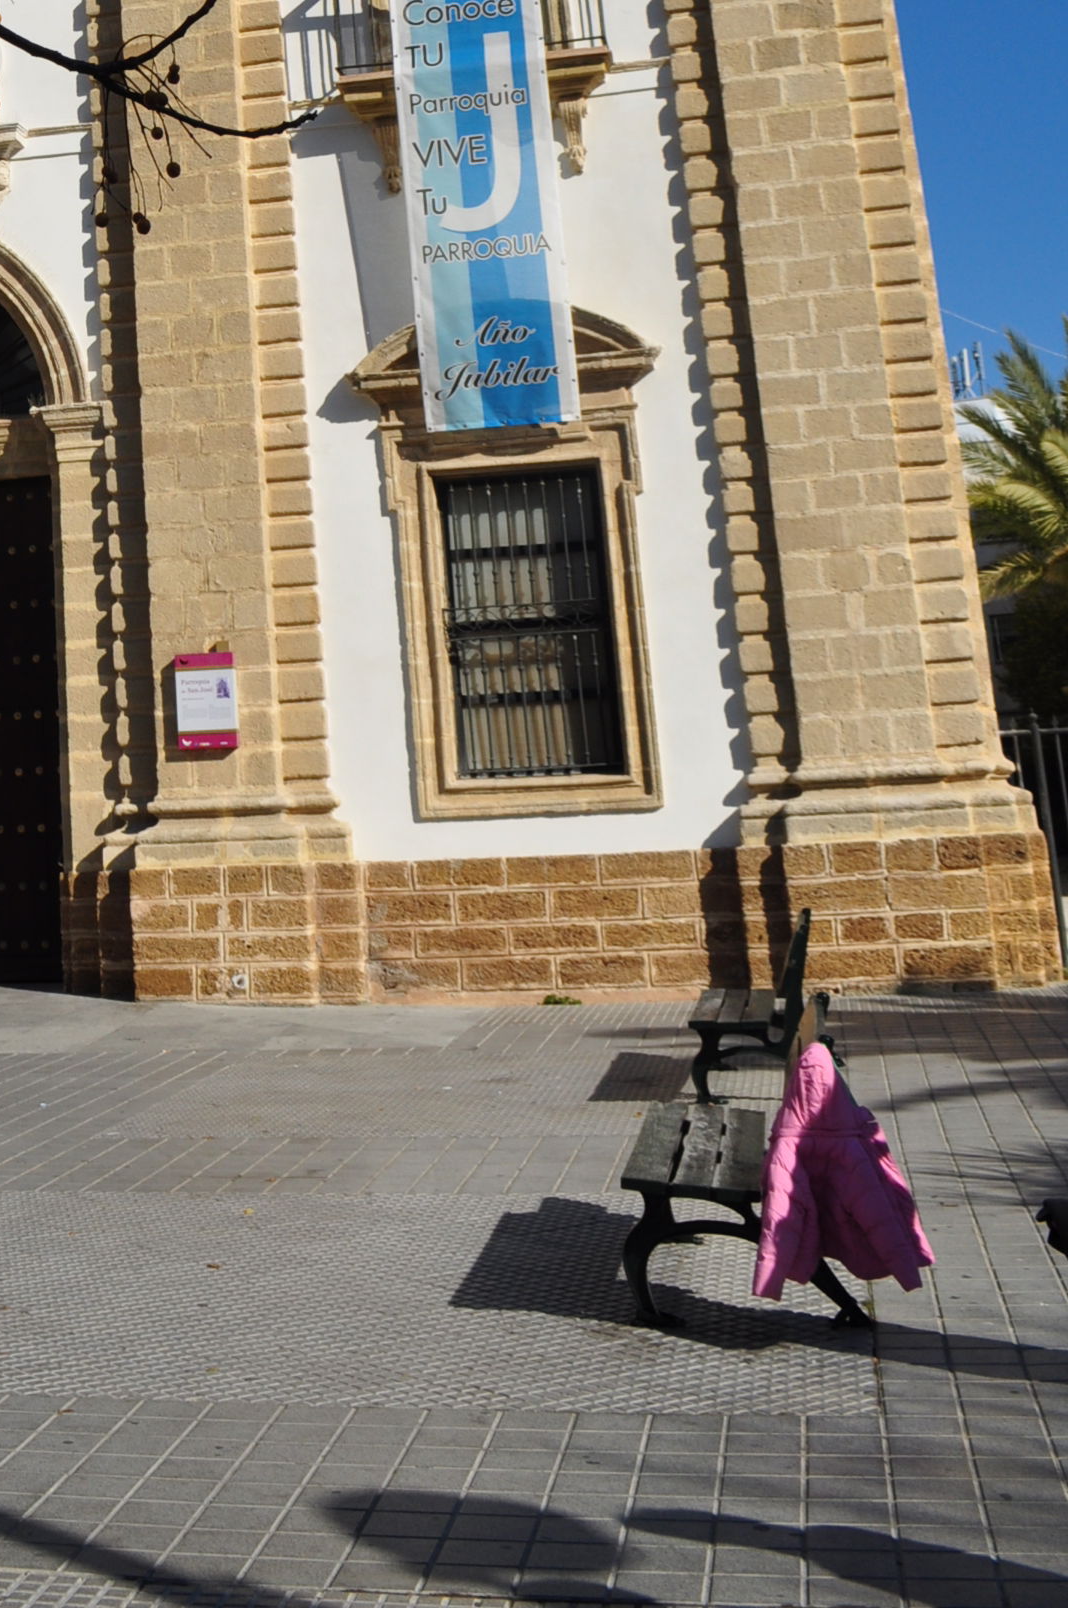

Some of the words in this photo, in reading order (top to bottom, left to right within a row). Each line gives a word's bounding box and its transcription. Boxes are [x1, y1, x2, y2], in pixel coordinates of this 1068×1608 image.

[404, 42, 443, 68] TU
[409, 83, 526, 114] Parroquia
[412, 135, 487, 168] VIVE
[416, 188, 447, 215] Tu
[422, 234, 552, 264] PARROQUIA
[455, 317, 537, 347] Año
[434, 357, 561, 401] Jubilar
